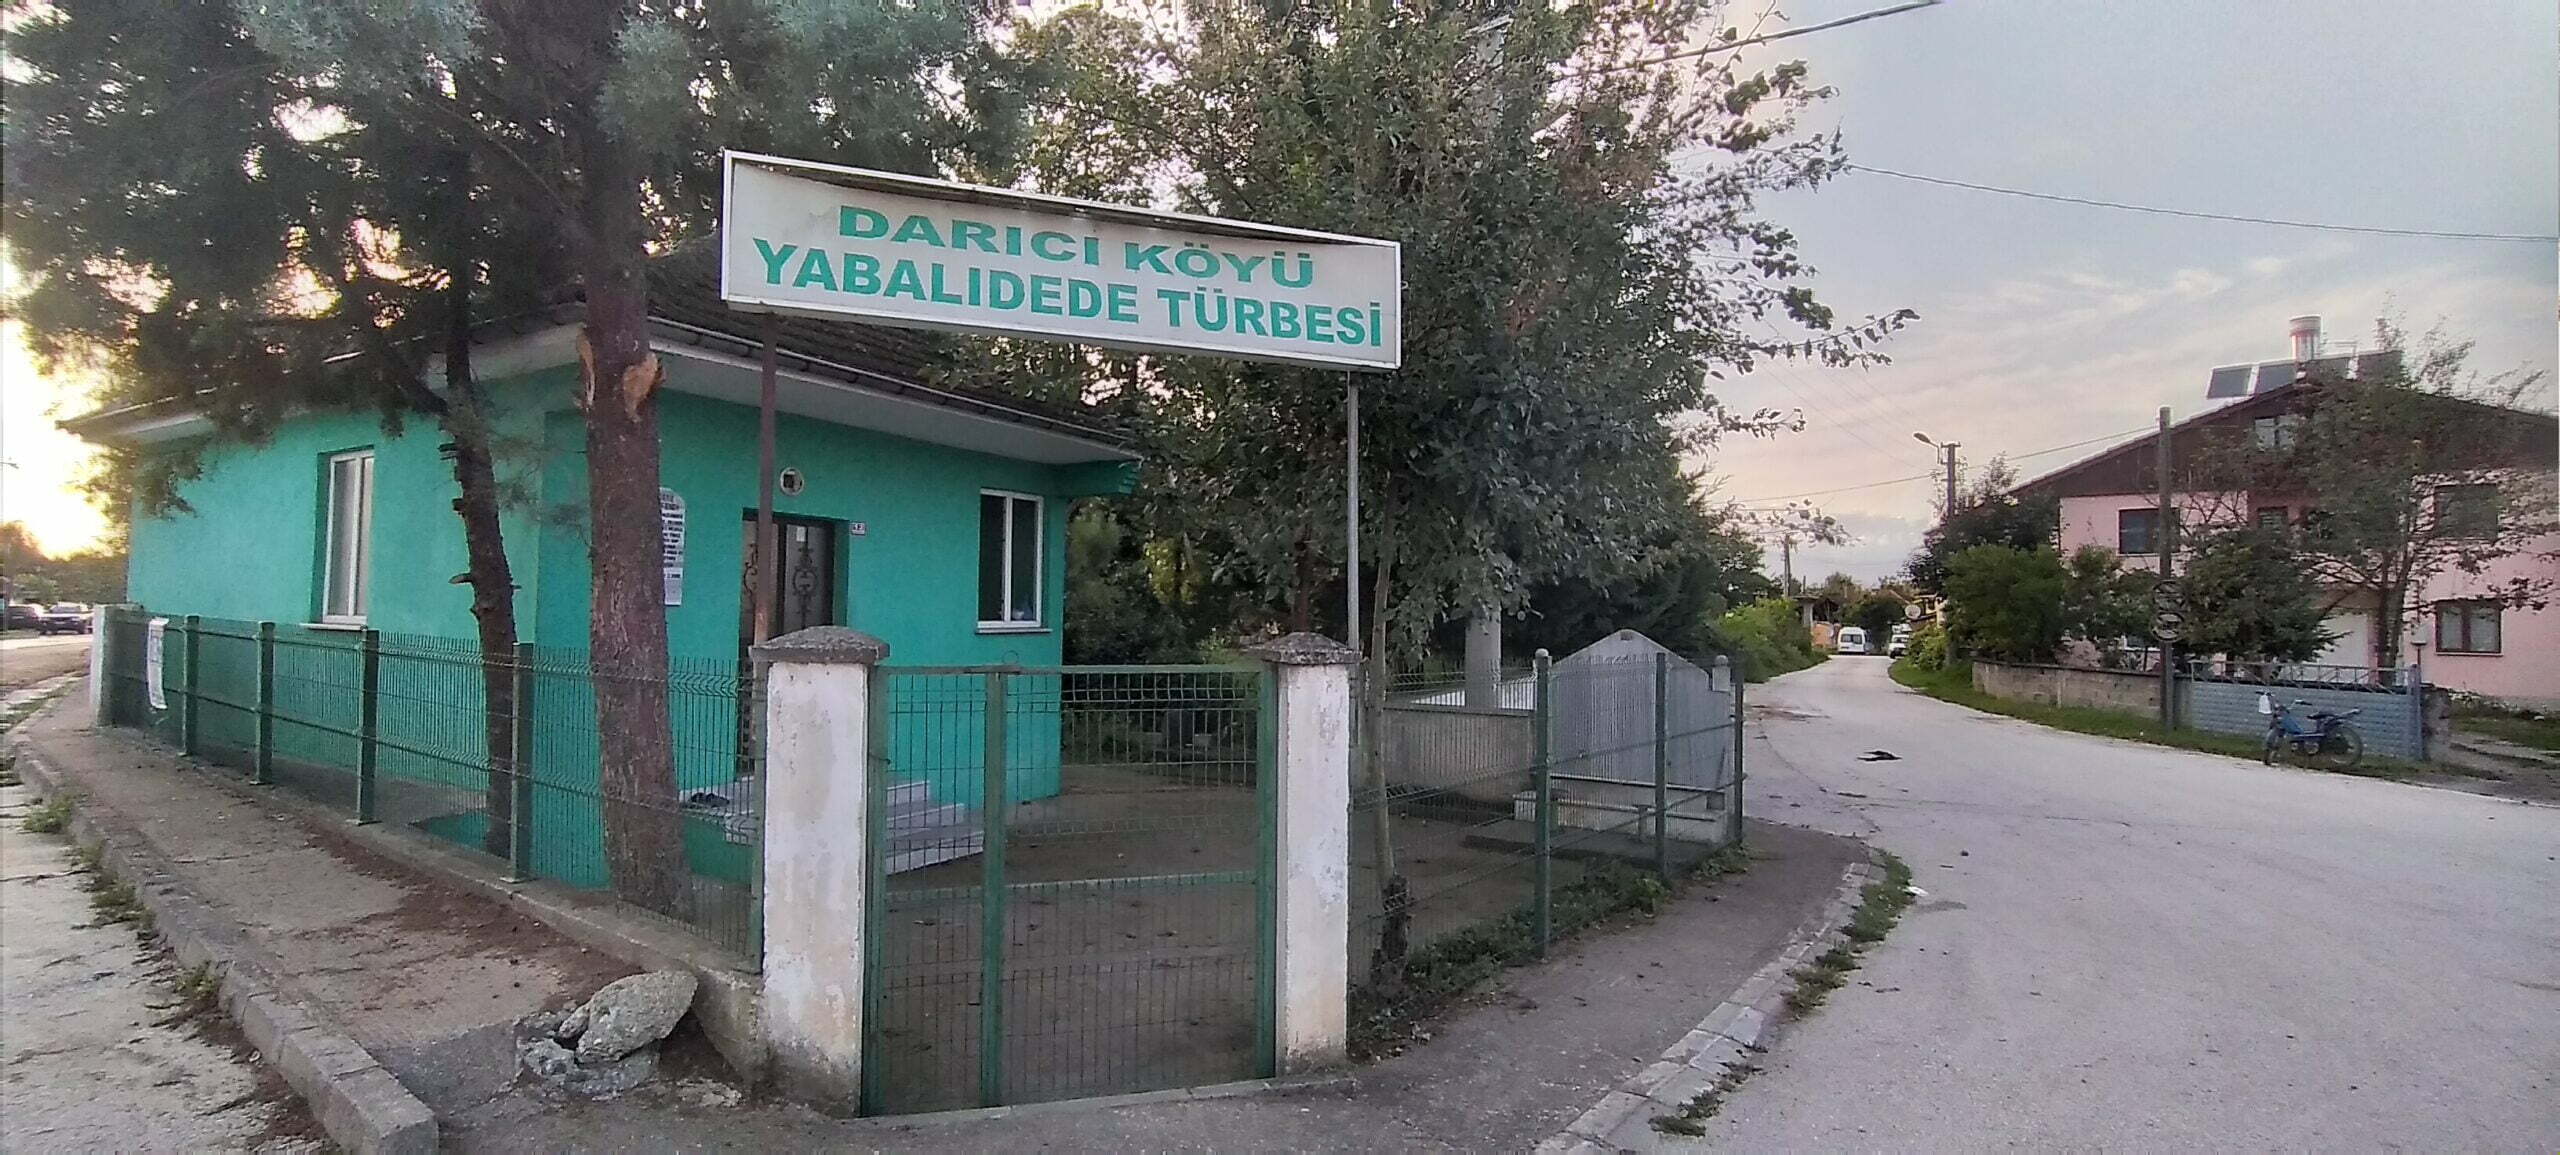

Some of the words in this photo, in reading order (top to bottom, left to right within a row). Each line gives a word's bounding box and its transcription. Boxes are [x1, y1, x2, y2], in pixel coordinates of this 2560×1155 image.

[753, 238, 1140, 323] YABALIDEDE
[1156, 286, 1383, 348] TÜRBESİ
[838, 206, 1100, 266] DARICI
[1124, 241, 1315, 289] KÖYÜ
